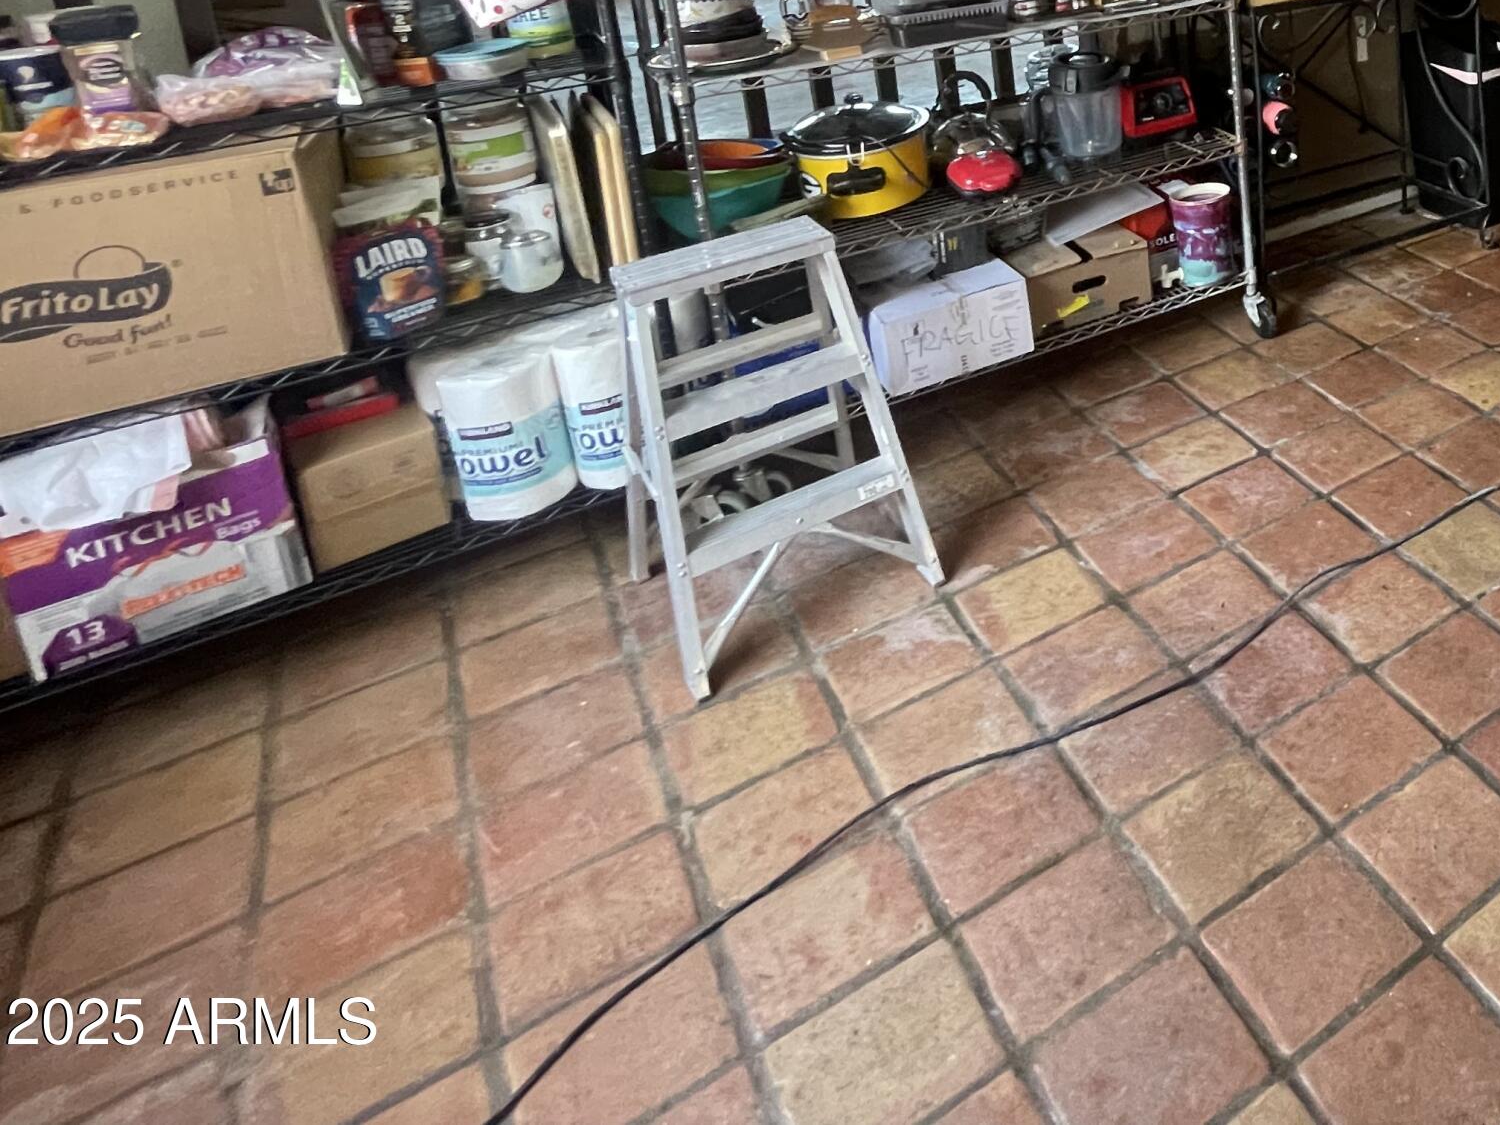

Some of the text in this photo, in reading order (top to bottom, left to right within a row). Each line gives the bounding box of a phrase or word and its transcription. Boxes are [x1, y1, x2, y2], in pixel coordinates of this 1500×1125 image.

[53, 169, 239, 209] FOODSERVICE
[354, 237, 427, 279] LAIRD
[63, 329, 124, 348] Good
[459, 435, 546, 475] owel
[65, 496, 232, 569] KITCHEN
[215, 516, 262, 540] Bags
[65, 621, 106, 646] 13
